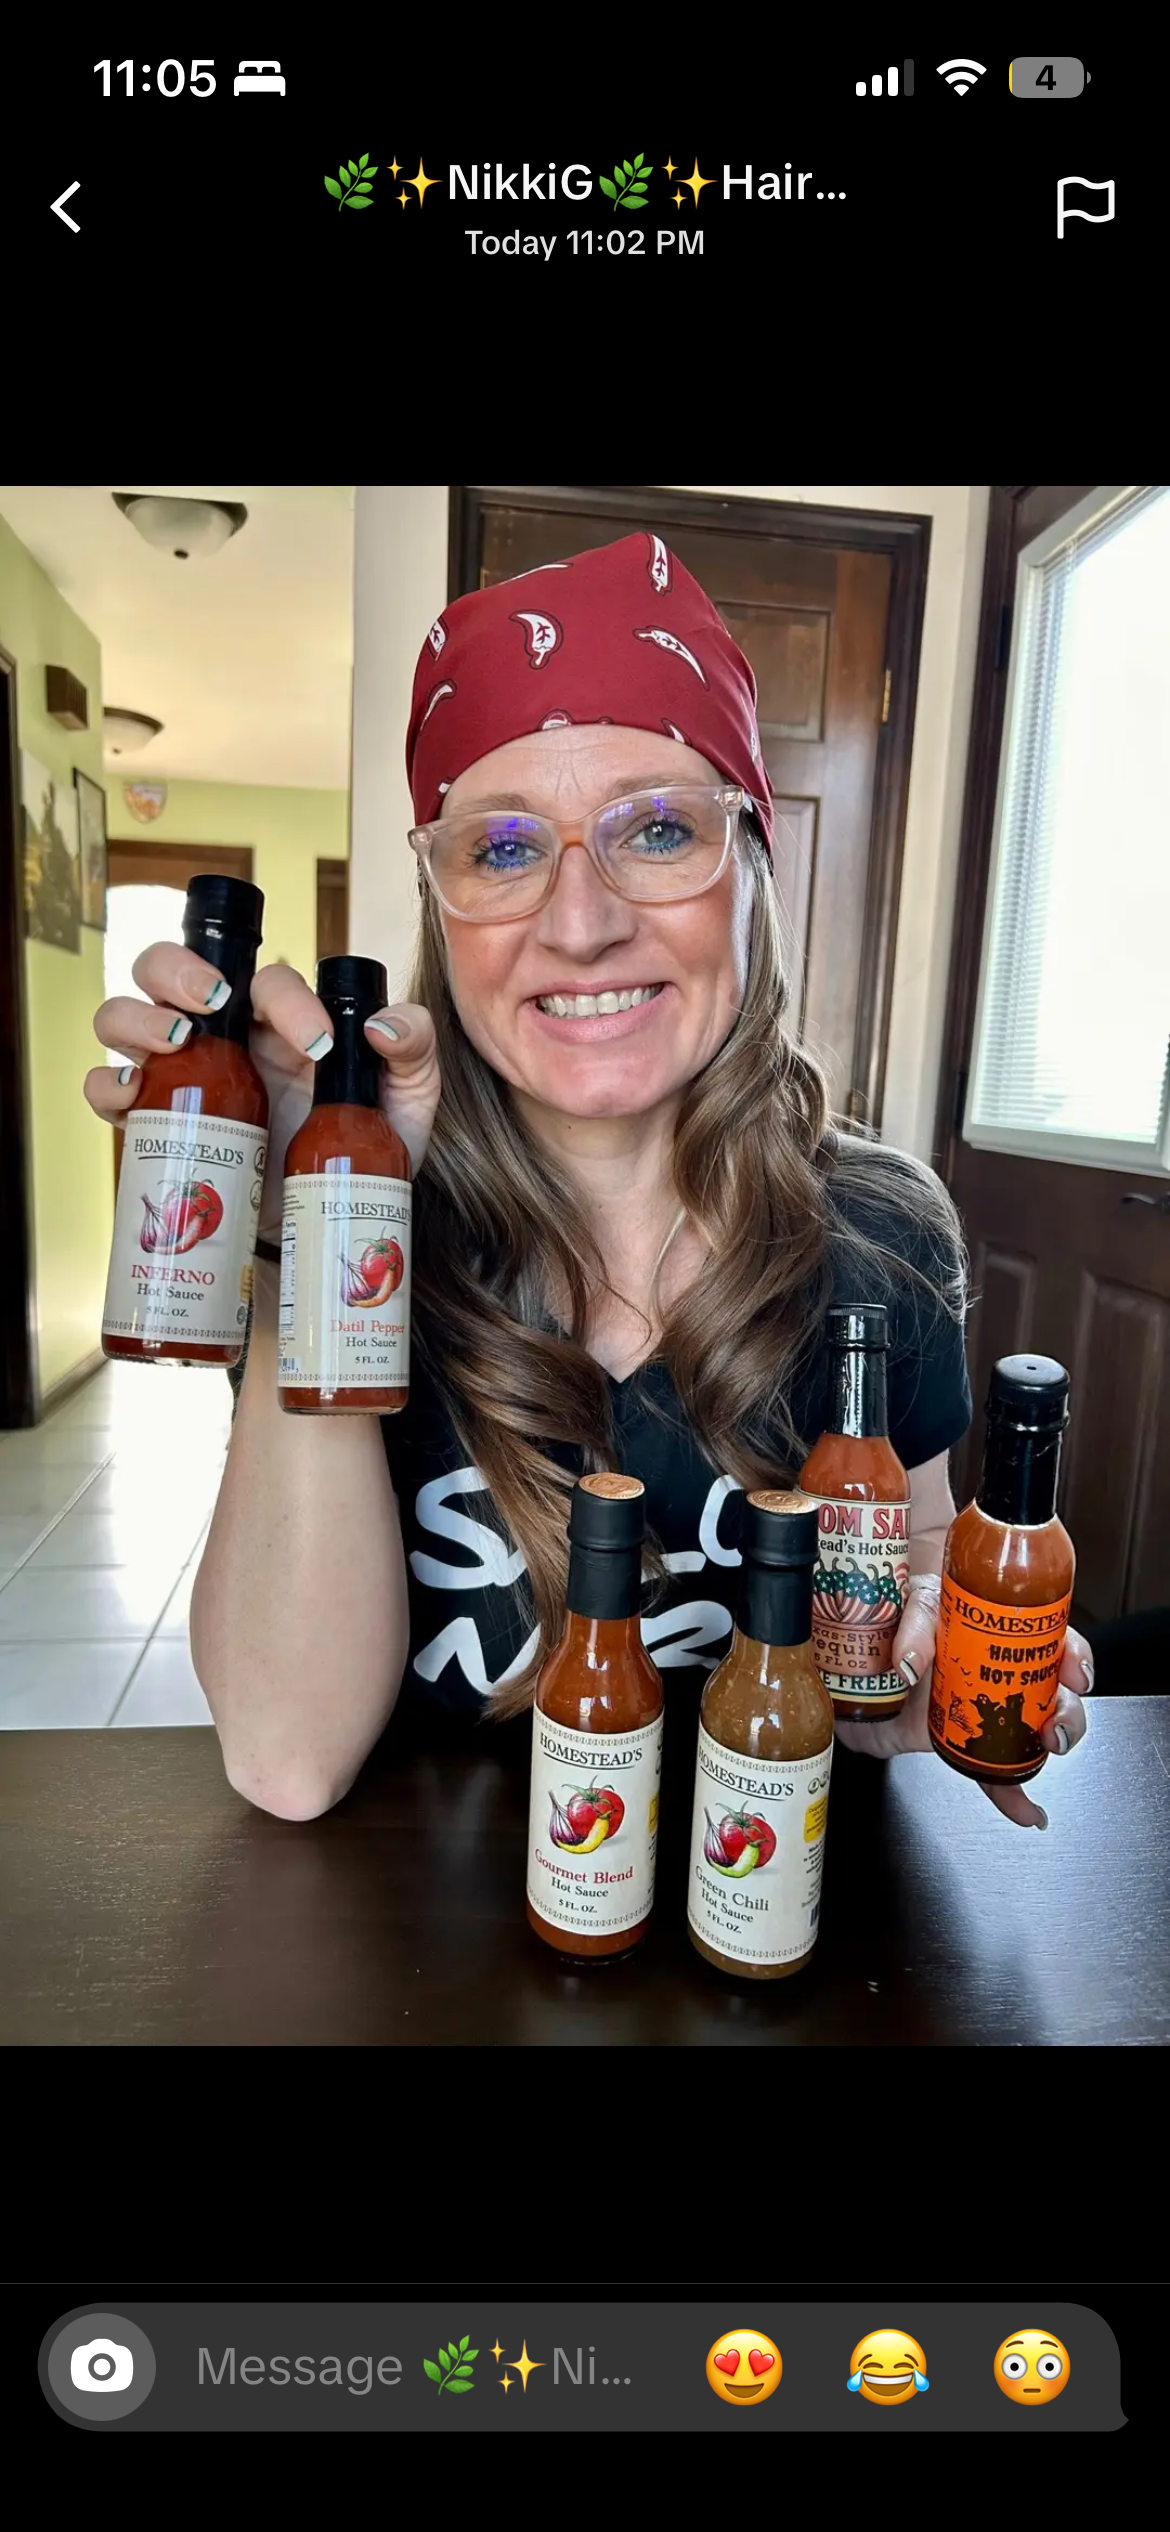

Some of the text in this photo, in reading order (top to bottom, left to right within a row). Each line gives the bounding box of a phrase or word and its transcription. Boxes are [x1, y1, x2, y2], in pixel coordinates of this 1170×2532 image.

[134, 1138, 244, 1165] HOMESTEAD'S
[131, 1264, 215, 1286] INFERNO
[137, 1282, 204, 1301] Hot Sauce
[171, 1307, 189, 1318] OZ.
[331, 1319, 405, 1337] Datil Pepper
[346, 1336, 397, 1347] Hot Sauce
[355, 1356, 360, 1364] 5
[818, 1539, 855, 1554] ead's
[858, 1542, 883, 1555] Hot
[814, 1652, 868, 1668] 5 FL OZ
[988, 1639, 1059, 1663] HAUNTED
[979, 1664, 1015, 1686] HOT
[539, 1732, 643, 1767] HOMESTEAD'S
[698, 1746, 794, 1797] HOMESTEAD'S
[534, 1848, 587, 1883] Gourmet
[593, 1865, 633, 1884] Blend
[551, 1876, 609, 1898] Hot Sauce
[695, 1865, 727, 1900] Green
[732, 1892, 769, 1912] Chili
[701, 1887, 754, 1923] Hot Sauce
[706, 1909, 711, 1917] 5
